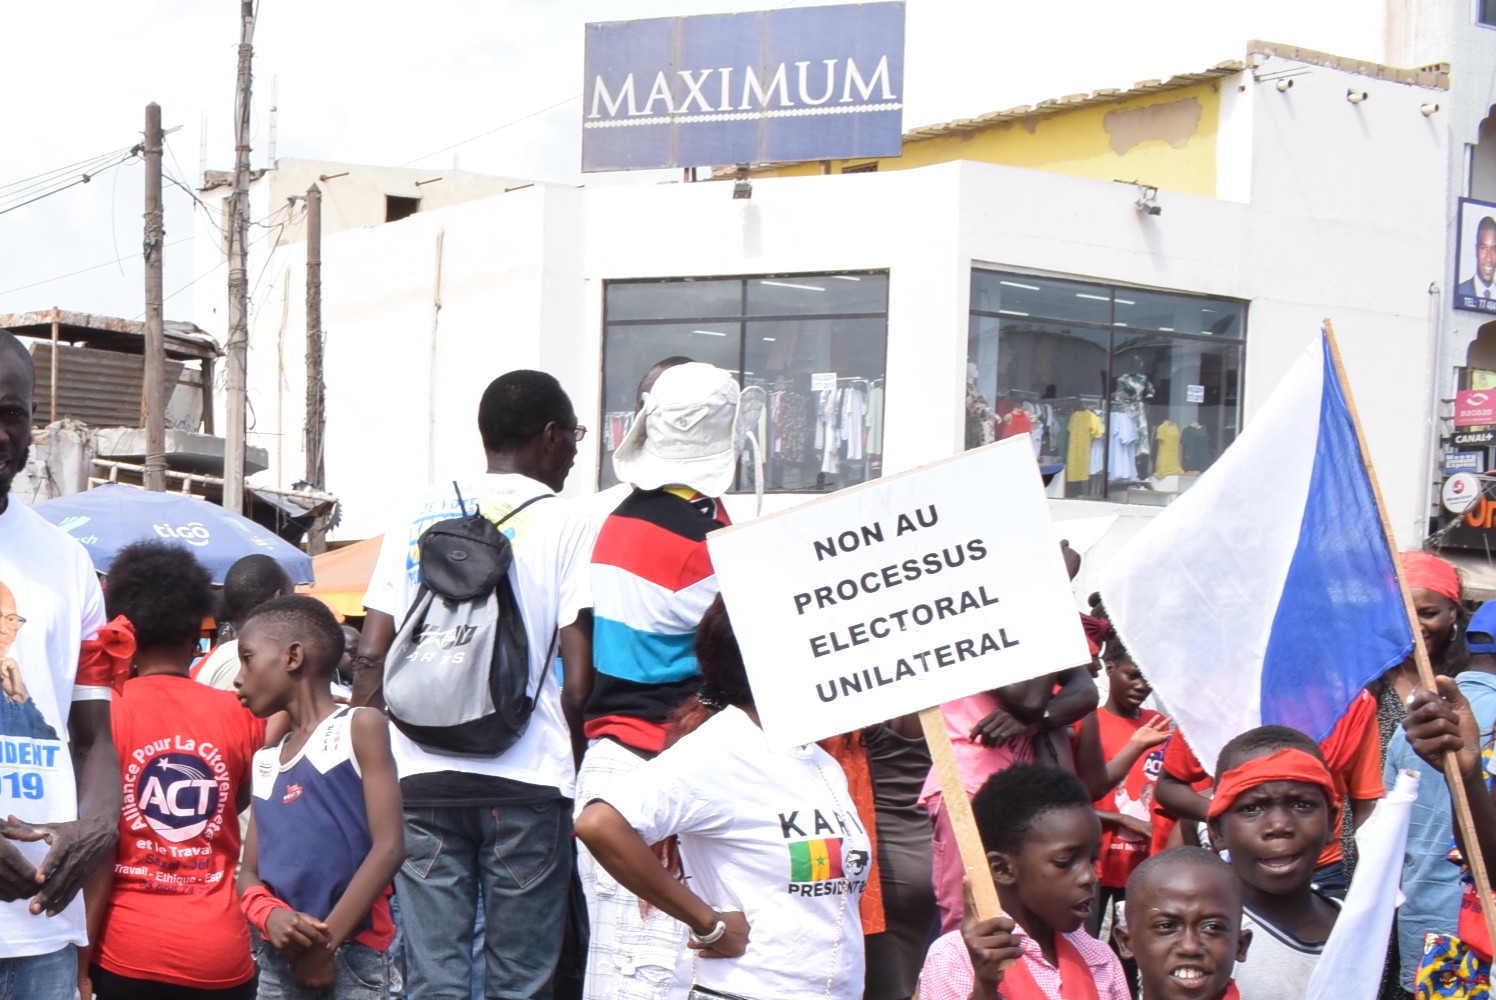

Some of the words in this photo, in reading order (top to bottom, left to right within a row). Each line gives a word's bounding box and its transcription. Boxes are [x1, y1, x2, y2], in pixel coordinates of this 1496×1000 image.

[587, 55, 897, 118] MAXIMUM
[1455, 433, 1494, 444] CANAL+
[813, 521, 885, 562] NON
[896, 504, 939, 537] AU
[793, 538, 988, 615] PROCESSUS
[809, 586, 1000, 659] ELECTORAL
[815, 627, 1020, 703] UNILATERAL
[132, 738, 172, 764] Pour
[175, 735, 196, 751] La
[122, 764, 148, 831] Alliance
[138, 776, 218, 817] ACT
[136, 840, 153, 850] et
[114, 864, 148, 876] Travail
[155, 871, 196, 886] Ethique
